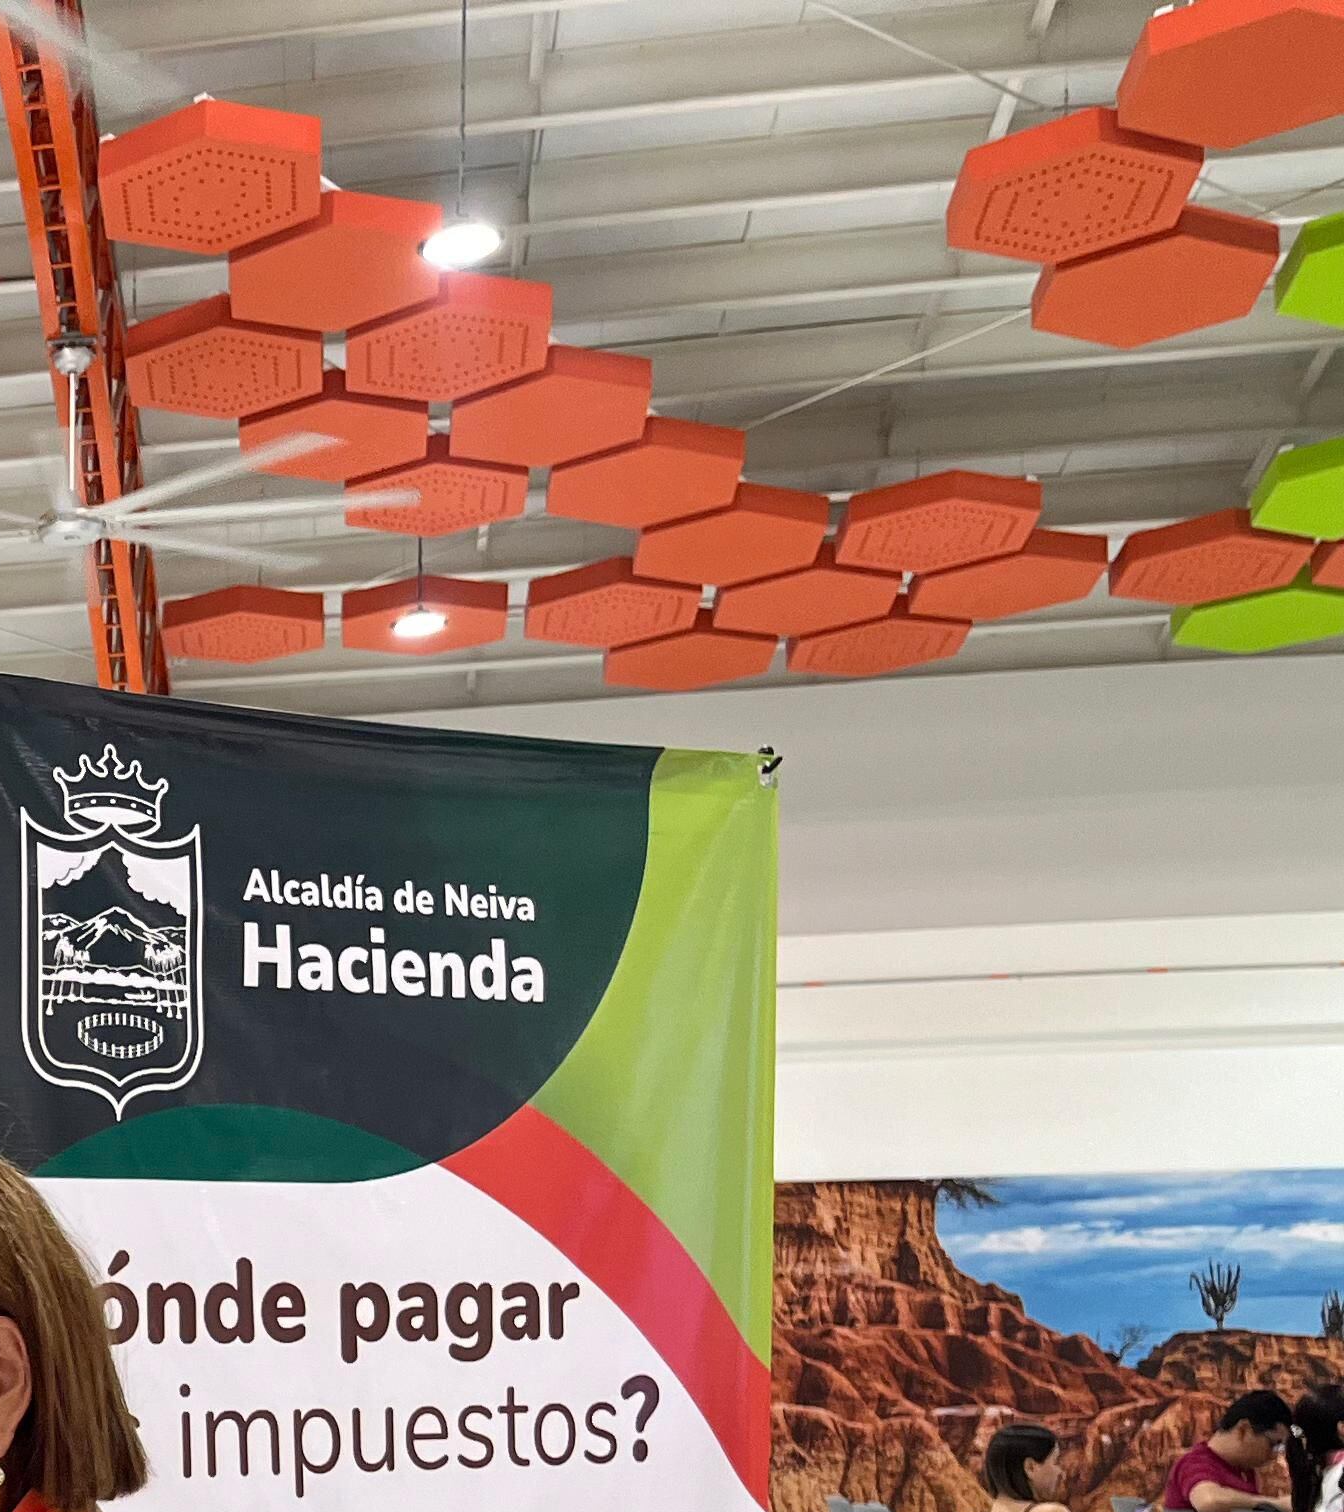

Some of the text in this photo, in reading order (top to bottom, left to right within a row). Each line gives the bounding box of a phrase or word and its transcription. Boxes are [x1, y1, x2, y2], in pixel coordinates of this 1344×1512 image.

[242, 867, 535, 922] Alcaldía de Neiva
[243, 921, 545, 1003] Hacienda
[93, 1249, 581, 1364] ónde pagar
[179, 1374, 660, 1499] impuestos?
